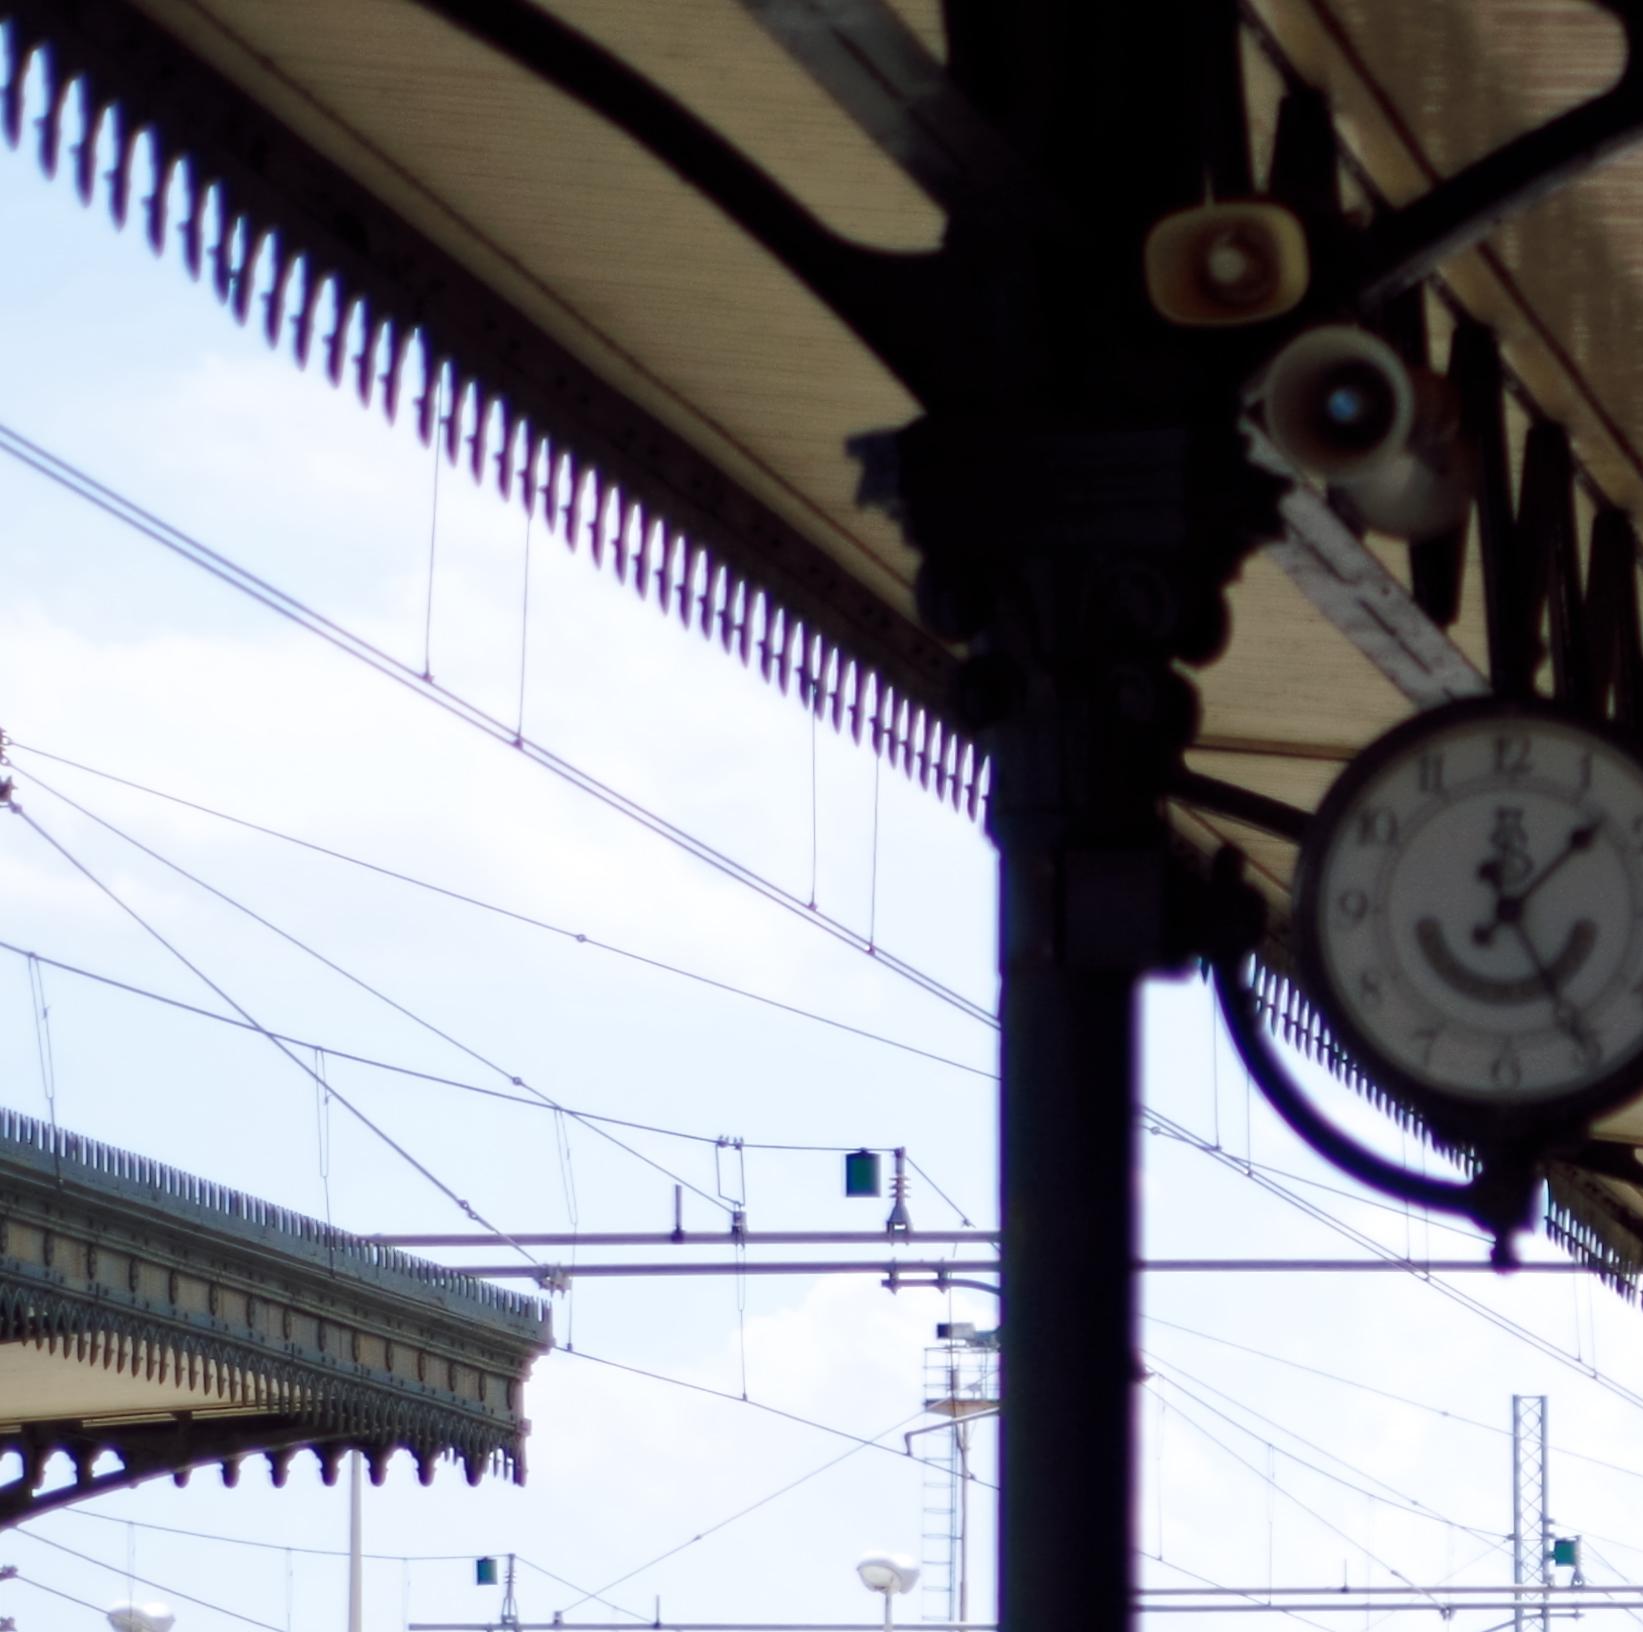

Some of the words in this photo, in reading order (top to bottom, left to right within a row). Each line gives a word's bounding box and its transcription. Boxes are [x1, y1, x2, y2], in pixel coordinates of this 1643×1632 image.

[1418, 753, 1446, 791] 11
[1492, 735, 1533, 774] 12
[1580, 751, 1594, 790] 1
[1356, 806, 1398, 845] 10
[1338, 890, 1369, 921] 9
[1360, 973, 1379, 1008] 8
[1412, 1026, 1440, 1067] 7
[1489, 1036, 1521, 1088] 6
